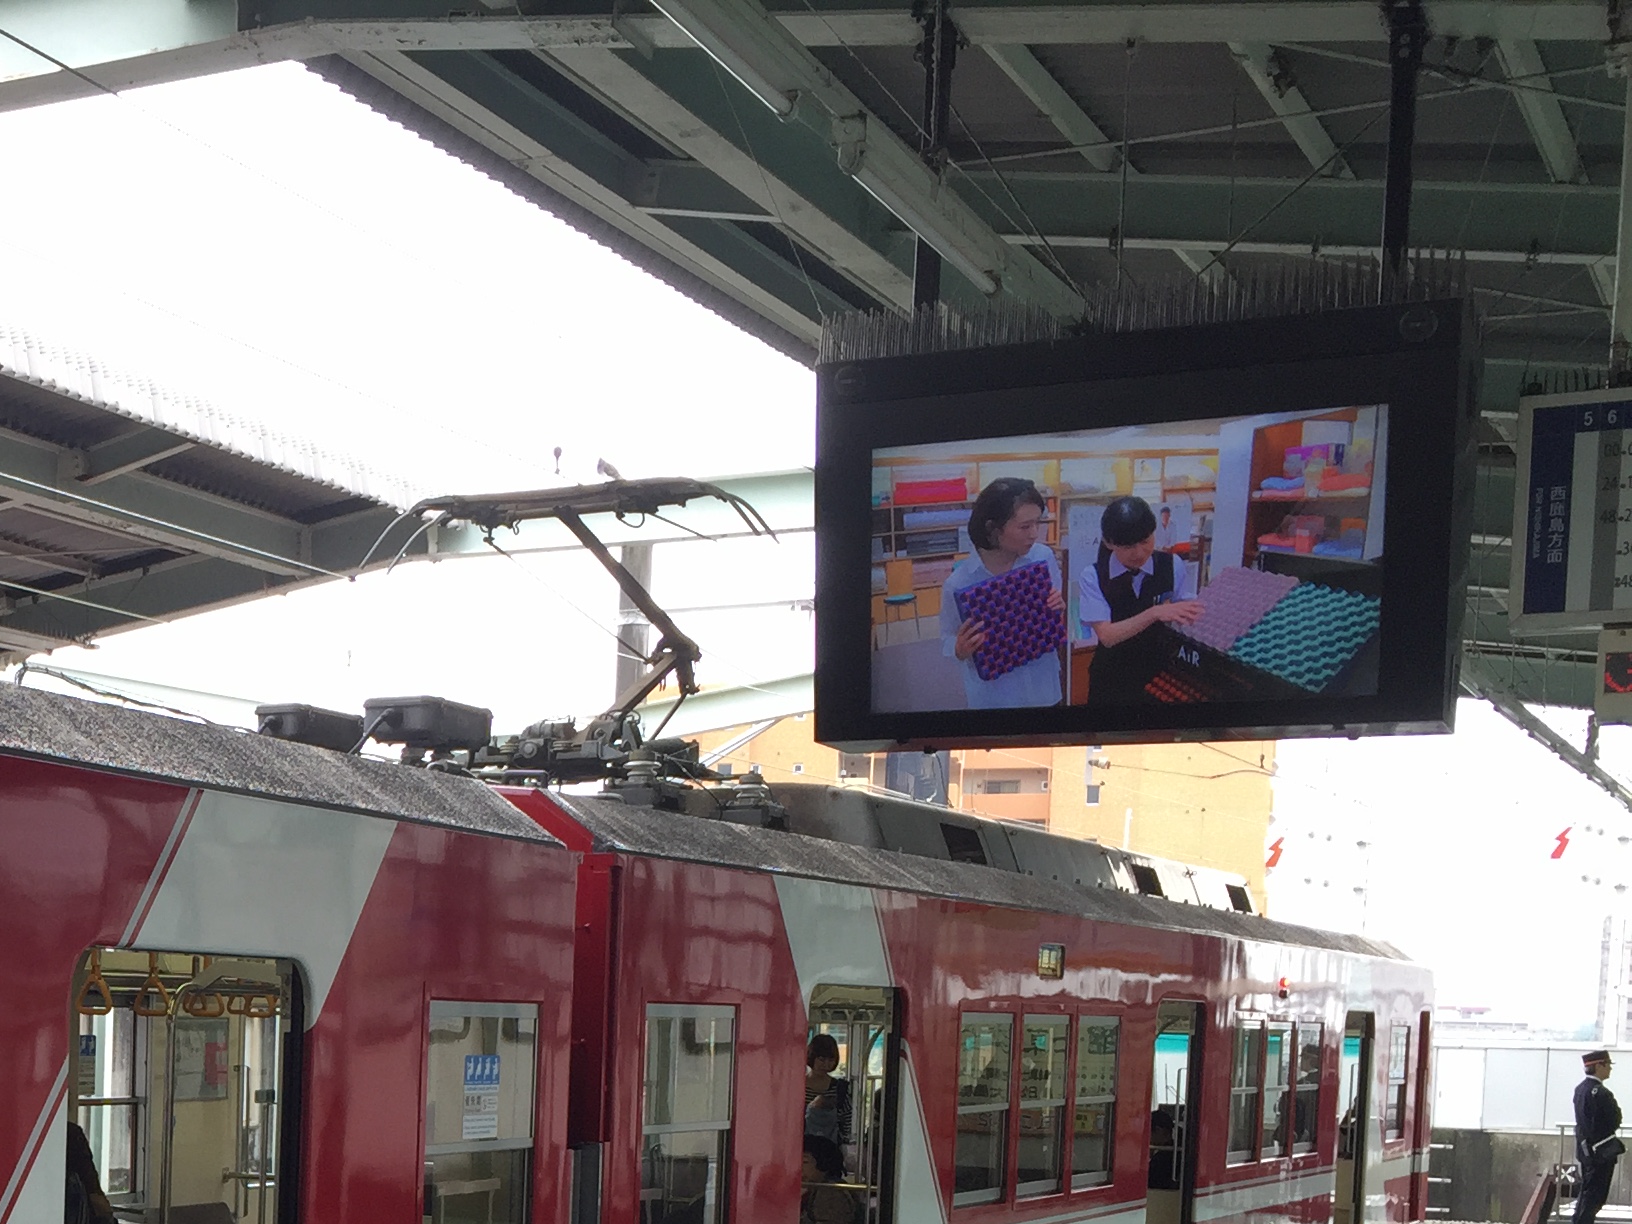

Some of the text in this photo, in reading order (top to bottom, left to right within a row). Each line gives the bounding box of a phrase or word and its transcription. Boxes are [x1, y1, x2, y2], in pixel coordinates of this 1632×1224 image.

[1583, 409, 1618, 426] 5 6
[1546, 485, 1567, 563] 西鹿島方面
